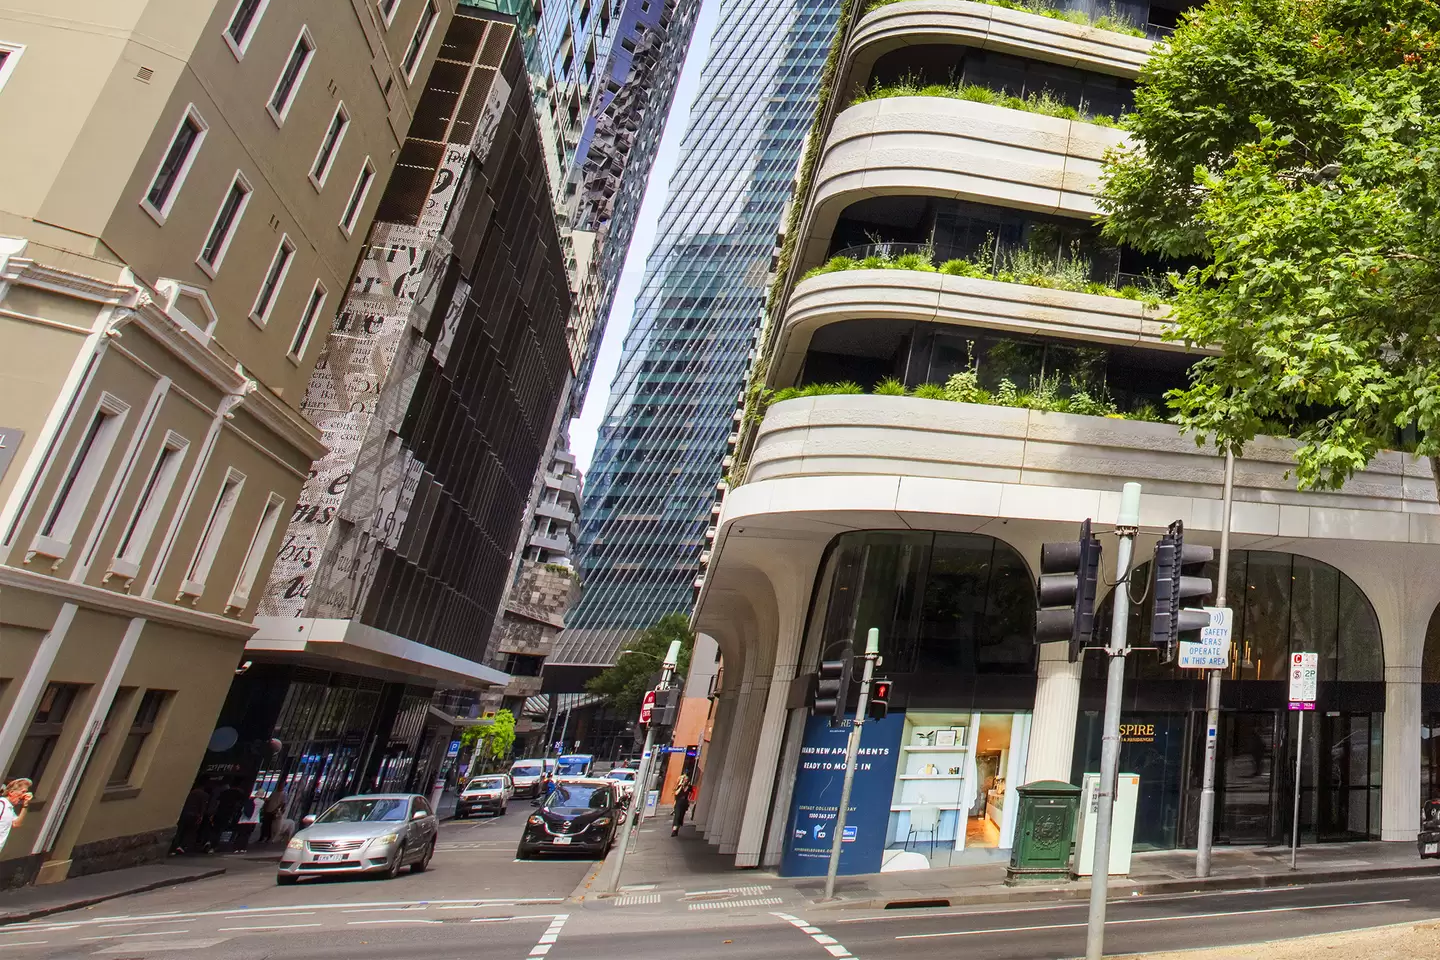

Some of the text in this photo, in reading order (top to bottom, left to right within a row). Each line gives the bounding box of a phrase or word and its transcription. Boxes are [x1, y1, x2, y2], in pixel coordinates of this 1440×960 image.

[1204, 628, 1228, 636] SAFETY
[1190, 647, 1221, 656] OPERATE
[1192, 657, 1206, 665] THIS
[1208, 657, 1226, 666] AREA
[1304, 670, 1316, 678] 2P
[1119, 724, 1155, 736] SPIRE
[816, 747, 830, 755] NEW
